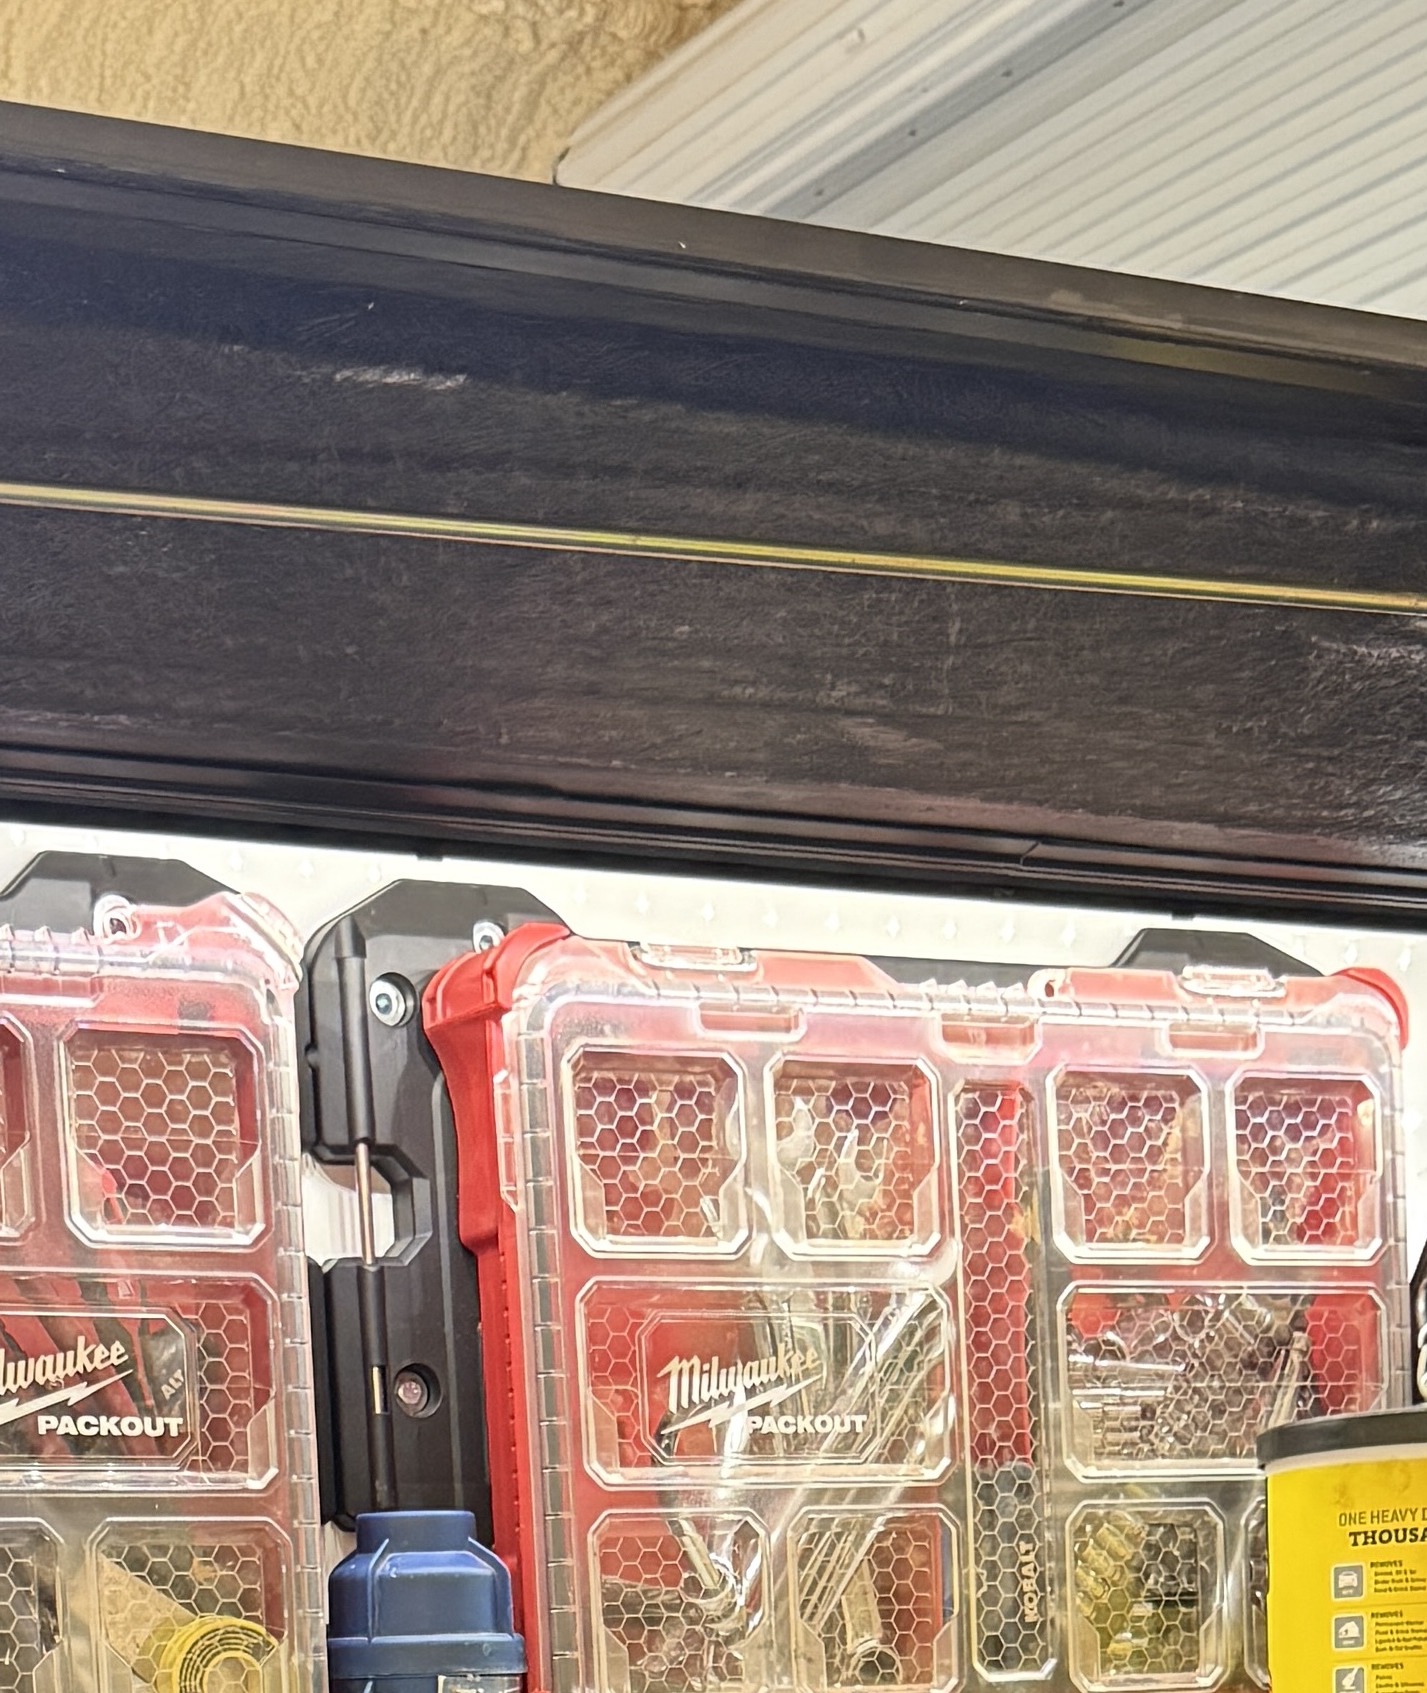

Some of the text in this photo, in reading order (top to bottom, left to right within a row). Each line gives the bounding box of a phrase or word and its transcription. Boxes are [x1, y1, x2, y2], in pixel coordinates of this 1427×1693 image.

[656, 1343, 821, 1414] Milwaukee
[37, 1414, 184, 1438] PACKOUT
[748, 1414, 867, 1434] PACKOUT
[1339, 1511, 1367, 1527] ONE
[1370, 1507, 1418, 1526] HEAVY
[1019, 1541, 1039, 1622] KOBALT
